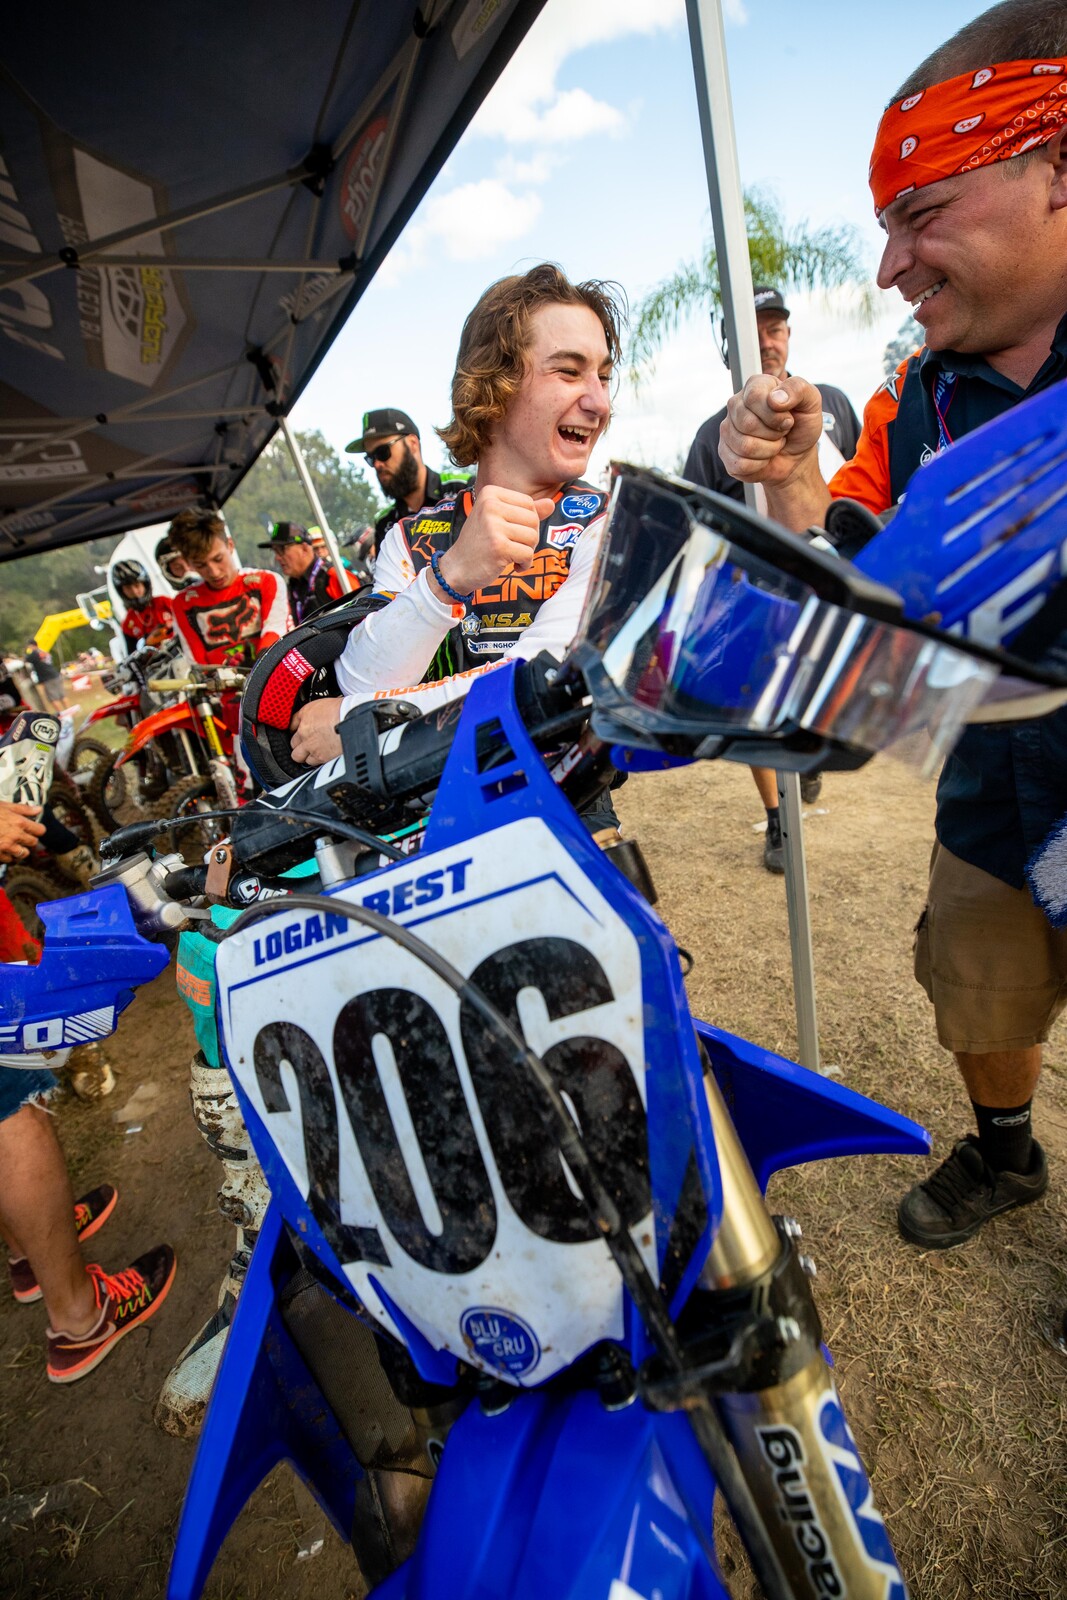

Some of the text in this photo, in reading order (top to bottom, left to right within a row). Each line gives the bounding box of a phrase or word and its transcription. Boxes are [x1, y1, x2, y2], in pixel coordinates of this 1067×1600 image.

[253, 857, 474, 966] LOGAN BEST
[254, 936, 652, 1275] 206
[469, 1318, 501, 1338] BLU
[493, 1333, 527, 1357] CRU
